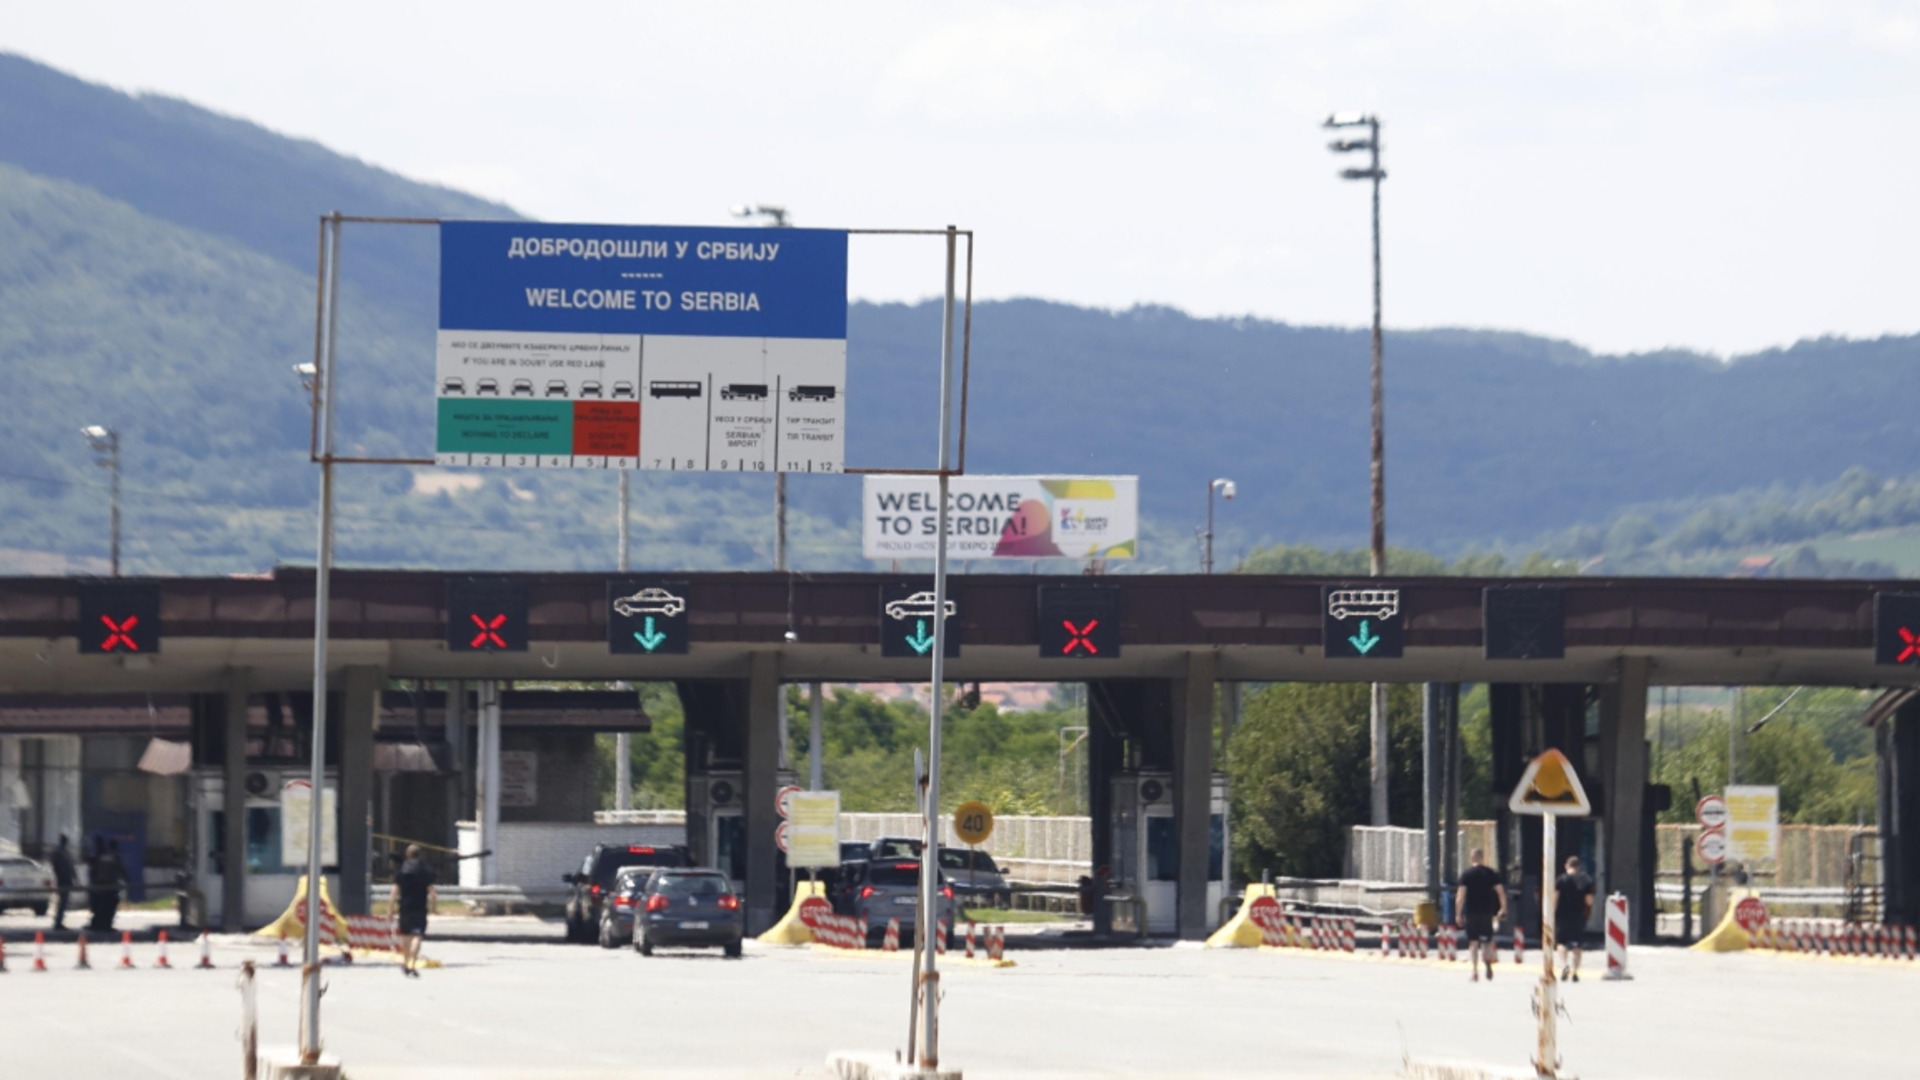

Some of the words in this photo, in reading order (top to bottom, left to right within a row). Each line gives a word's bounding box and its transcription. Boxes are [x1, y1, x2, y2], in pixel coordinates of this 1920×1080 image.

[508, 237, 668, 260] ДОБРОДОШЛИ
[675, 241, 688, 258] У
[697, 242, 780, 261] СРБИЈУ
[526, 288, 636, 310] WELCOME
[642, 291, 671, 310] TO
[680, 291, 760, 312] SERBIA
[492, 358, 507, 366] ARE
[508, 358, 517, 366] IN
[519, 359, 547, 367] DOUBT
[549, 359, 564, 367] USE
[566, 359, 583, 368] RED
[584, 360, 606, 368] LANE
[462, 431, 498, 439] NOTHING
[499, 431, 510, 439] TO
[512, 431, 549, 439] DECLARE
[725, 431, 761, 439] SERBIAN
[787, 433, 799, 441] TIR
[801, 433, 834, 441] TRANSIT
[728, 440, 758, 448] IMPORT
[484, 457, 491, 465] 2
[518, 457, 526, 465] 3
[551, 457, 558, 465] 4
[587, 458, 593, 467] 5
[619, 458, 626, 467] 6
[654, 459, 661, 467] 7
[687, 460, 694, 469] 8
[720, 460, 728, 470] 9
[752, 461, 765, 471] 10
[787, 462, 799, 470] 11
[820, 462, 832, 471] 12
[877, 516, 912, 535] TO
[962, 814, 984, 832] 40
